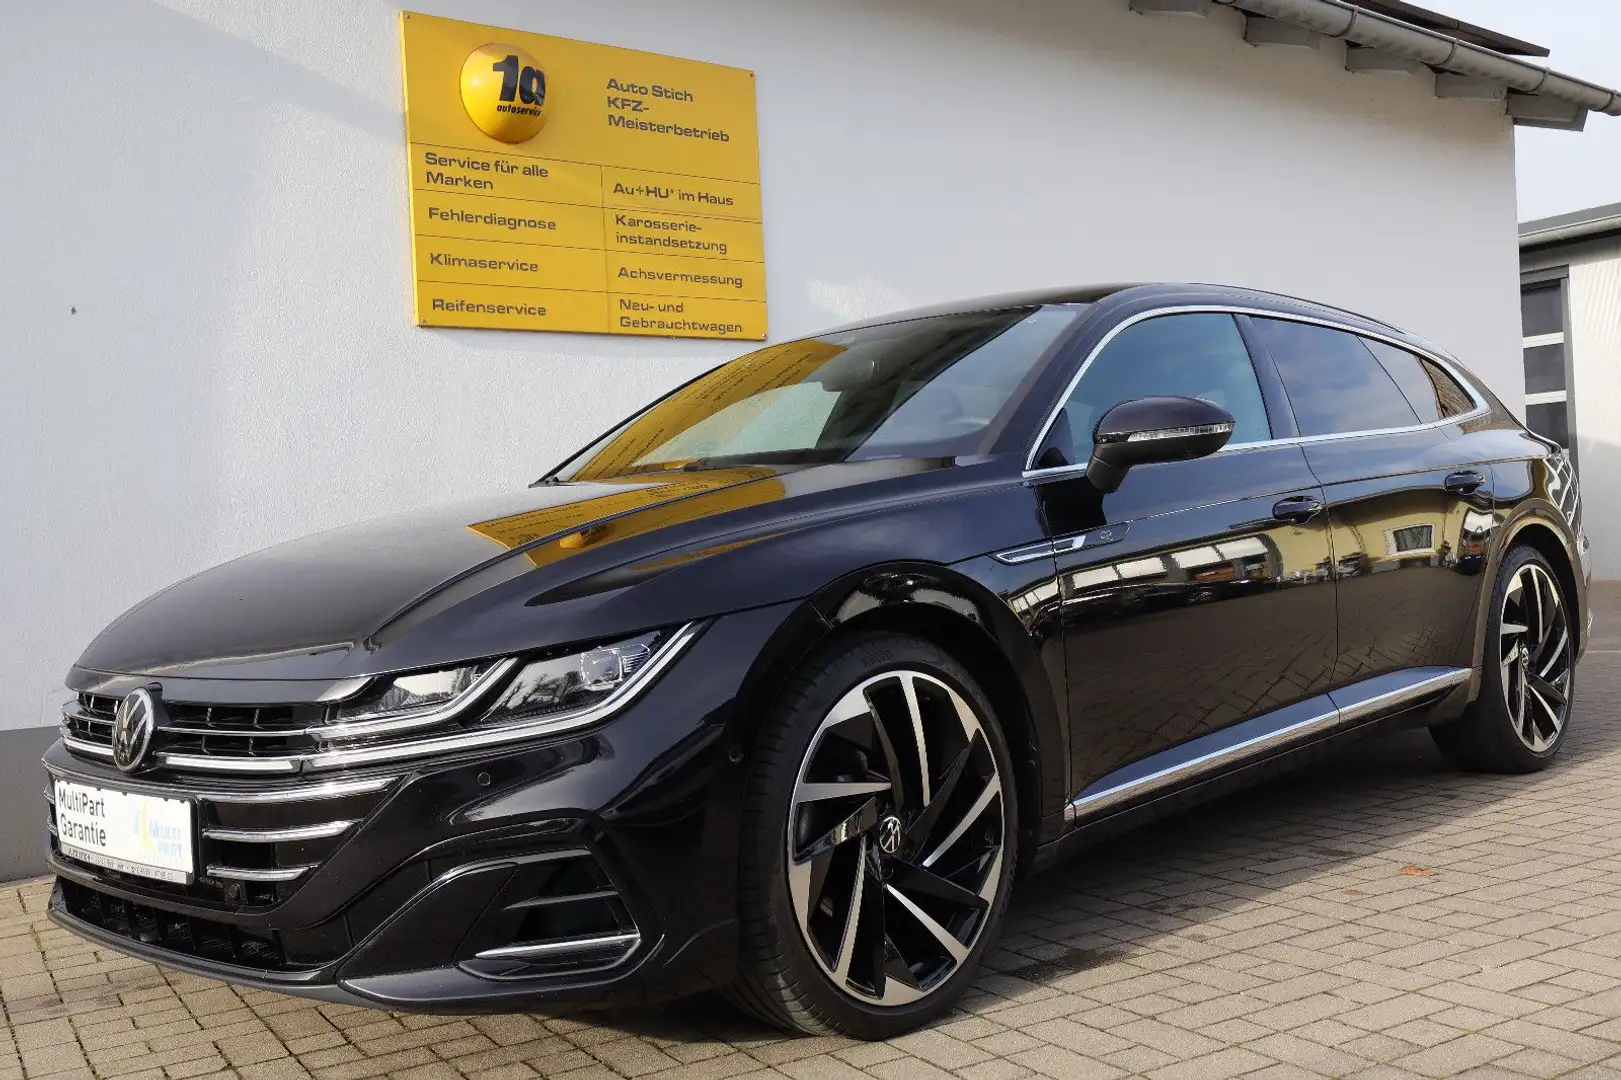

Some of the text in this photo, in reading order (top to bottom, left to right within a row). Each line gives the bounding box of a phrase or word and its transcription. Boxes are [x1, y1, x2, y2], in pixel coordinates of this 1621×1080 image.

[606, 77, 693, 102] Auto Stich
[496, 103, 543, 117] autoservice
[607, 96, 650, 113] KFZ-
[608, 114, 730, 142] Meisterbetrieb
[425, 152, 549, 178] Service für alle
[426, 171, 494, 190] Marken
[678, 190, 695, 202] im
[698, 191, 734, 206] Haus
[428, 206, 557, 230] Fehlerdiagnose
[615, 215, 702, 233] Karosserie-
[616, 232, 728, 255] instandsetzung
[430, 252, 539, 273] Klimaservice
[617, 266, 744, 289] Achsvermessung
[432, 297, 547, 317] Reifenservice
[619, 298, 684, 314] Neu- und
[619, 315, 743, 335] Gebrauchtwagen
[58, 787, 105, 818] MultiPart
[60, 813, 106, 847] Garantie
